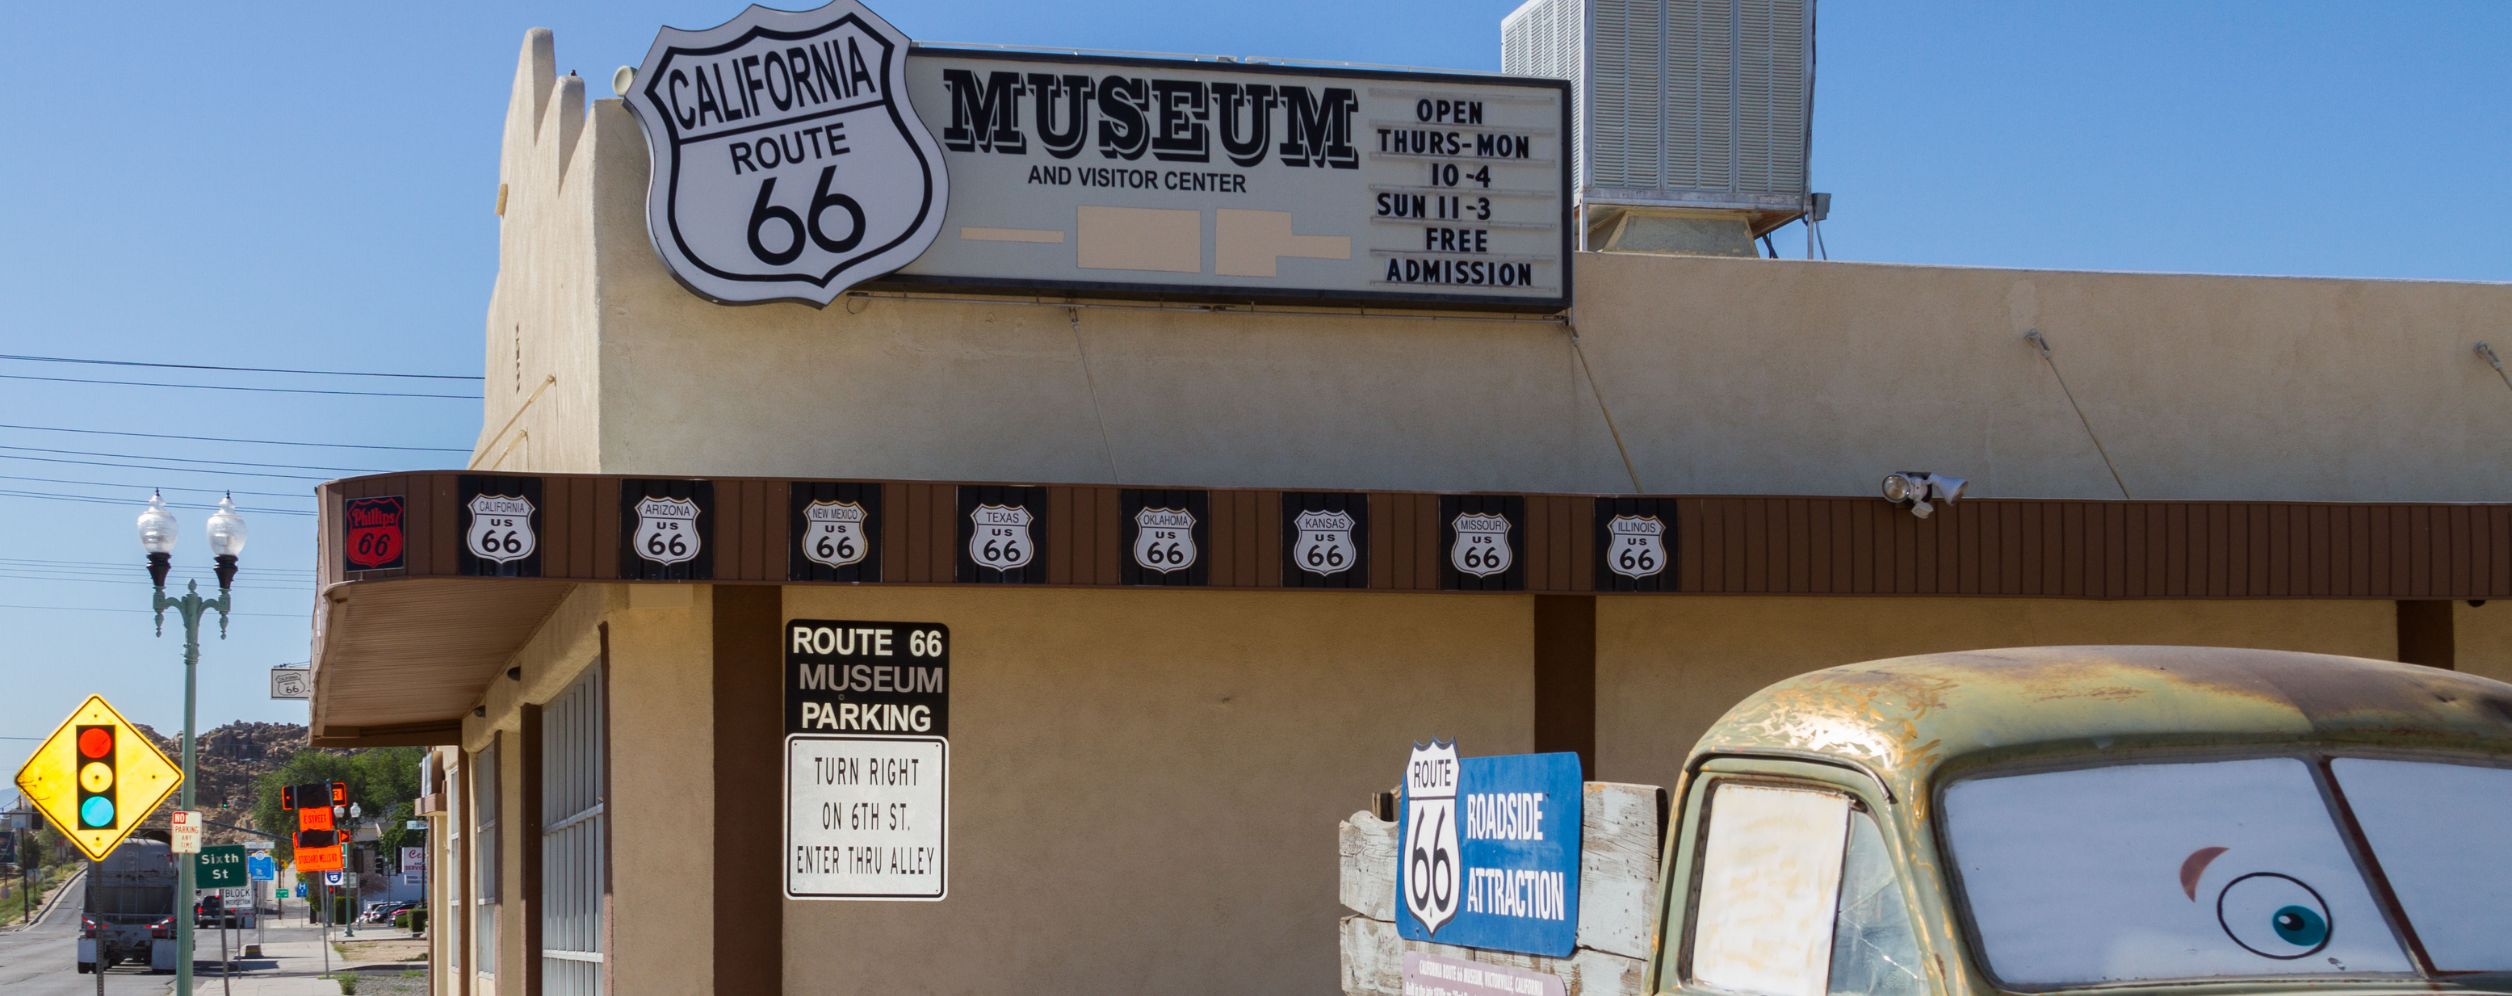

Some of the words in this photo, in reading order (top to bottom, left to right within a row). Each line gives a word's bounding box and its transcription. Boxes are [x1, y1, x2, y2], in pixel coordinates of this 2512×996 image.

[669, 36, 877, 131] CALIFORNIA
[943, 69, 1360, 170] MUSEUM
[1416, 98, 1484, 126] OPEN
[729, 122, 851, 175] ROUTE
[1377, 128, 1531, 160] THURS-MON
[1028, 165, 1072, 187] AND
[1079, 167, 1159, 191] VISITOR
[1164, 170, 1248, 194] CENTER
[747, 165, 867, 266] 66
[1377, 193, 1426, 219] SUN
[1426, 228, 1488, 252] FREE
[1386, 258, 1532, 287] ADMISSION
[353, 510, 397, 528] Phillips
[479, 502, 525, 514] CALIFORNIA
[645, 504, 691, 517] ARIZONA
[812, 507, 829, 520] NEW
[831, 508, 858, 520] MEXICO
[986, 511, 1020, 524] TEXAS
[1143, 513, 1189, 527] OKLAHOMA
[1305, 517, 1345, 530] KANSAS
[1460, 519, 1504, 532] MISSOURI
[1618, 521, 1657, 534] ILLINOIS
[358, 532, 391, 557] 66
[482, 529, 522, 555] 66
[648, 533, 687, 557] 66
[816, 536, 855, 560] 66
[983, 539, 1022, 562] 66
[1147, 542, 1184, 565] 66
[1307, 545, 1344, 567] 66
[1464, 546, 1501, 569] 66
[1619, 548, 1655, 570] 66
[793, 627, 893, 656] ROUTE
[909, 630, 943, 657] 66
[286, 685, 299, 694] 66
[800, 664, 943, 693] MUSEUM
[802, 702, 931, 732] PARKING
[815, 757, 859, 785] TURN
[870, 758, 919, 786] RIGHT
[1413, 759, 1451, 788] ROUTE
[174, 813, 185, 823] NO
[822, 802, 842, 830] ON
[852, 802, 879, 831] 6TH
[889, 803, 910, 831] ST.
[1467, 792, 1544, 841] ROADSIDE
[175, 826, 198, 834] PARKING
[201, 853, 239, 865] Sixth
[797, 846, 840, 874] ENTER
[848, 846, 882, 874] THRU
[891, 847, 935, 875] ALLEY
[1411, 805, 1451, 912] 66
[212, 869, 229, 879] St
[225, 888, 251, 898] BLOCK
[1467, 867, 1565, 921] ATTRACTION
